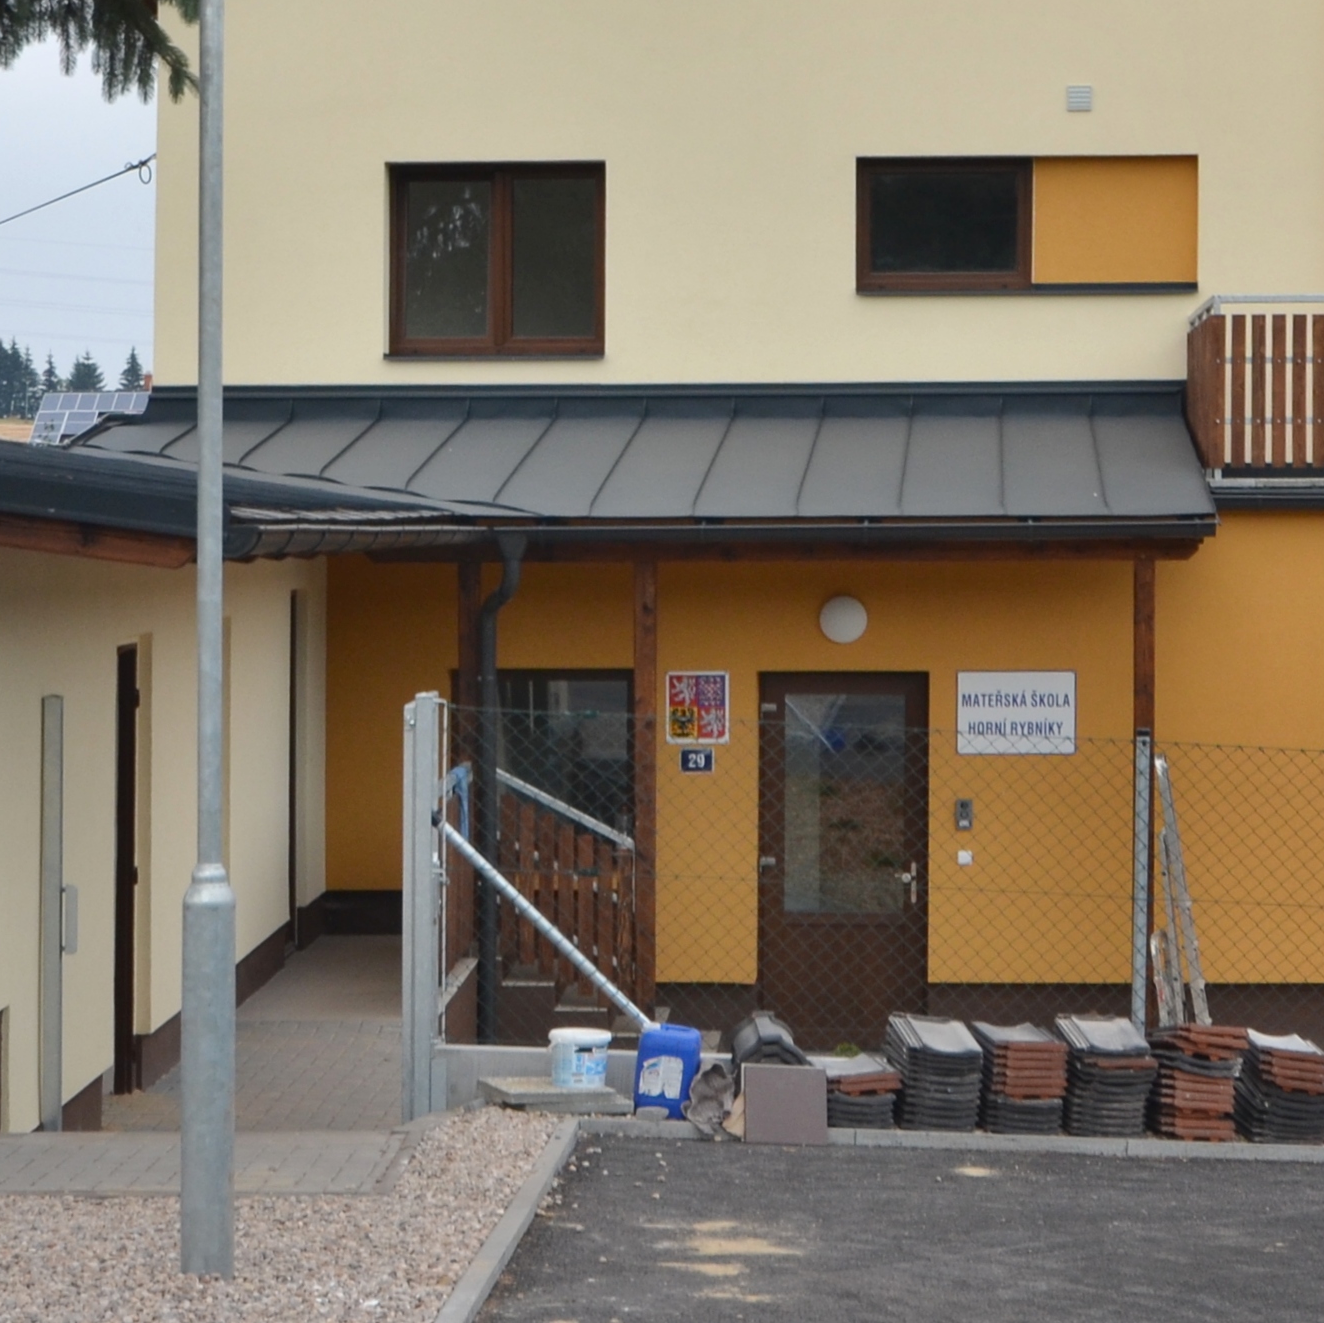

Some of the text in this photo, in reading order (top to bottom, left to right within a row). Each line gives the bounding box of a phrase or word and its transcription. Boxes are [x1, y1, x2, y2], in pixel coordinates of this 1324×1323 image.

[961, 689, 1071, 708] MATEŘSKÁ ŠKOLA
[968, 717, 1063, 736] HORNÍ RYBNÍKY
[688, 753, 705, 768] 29
